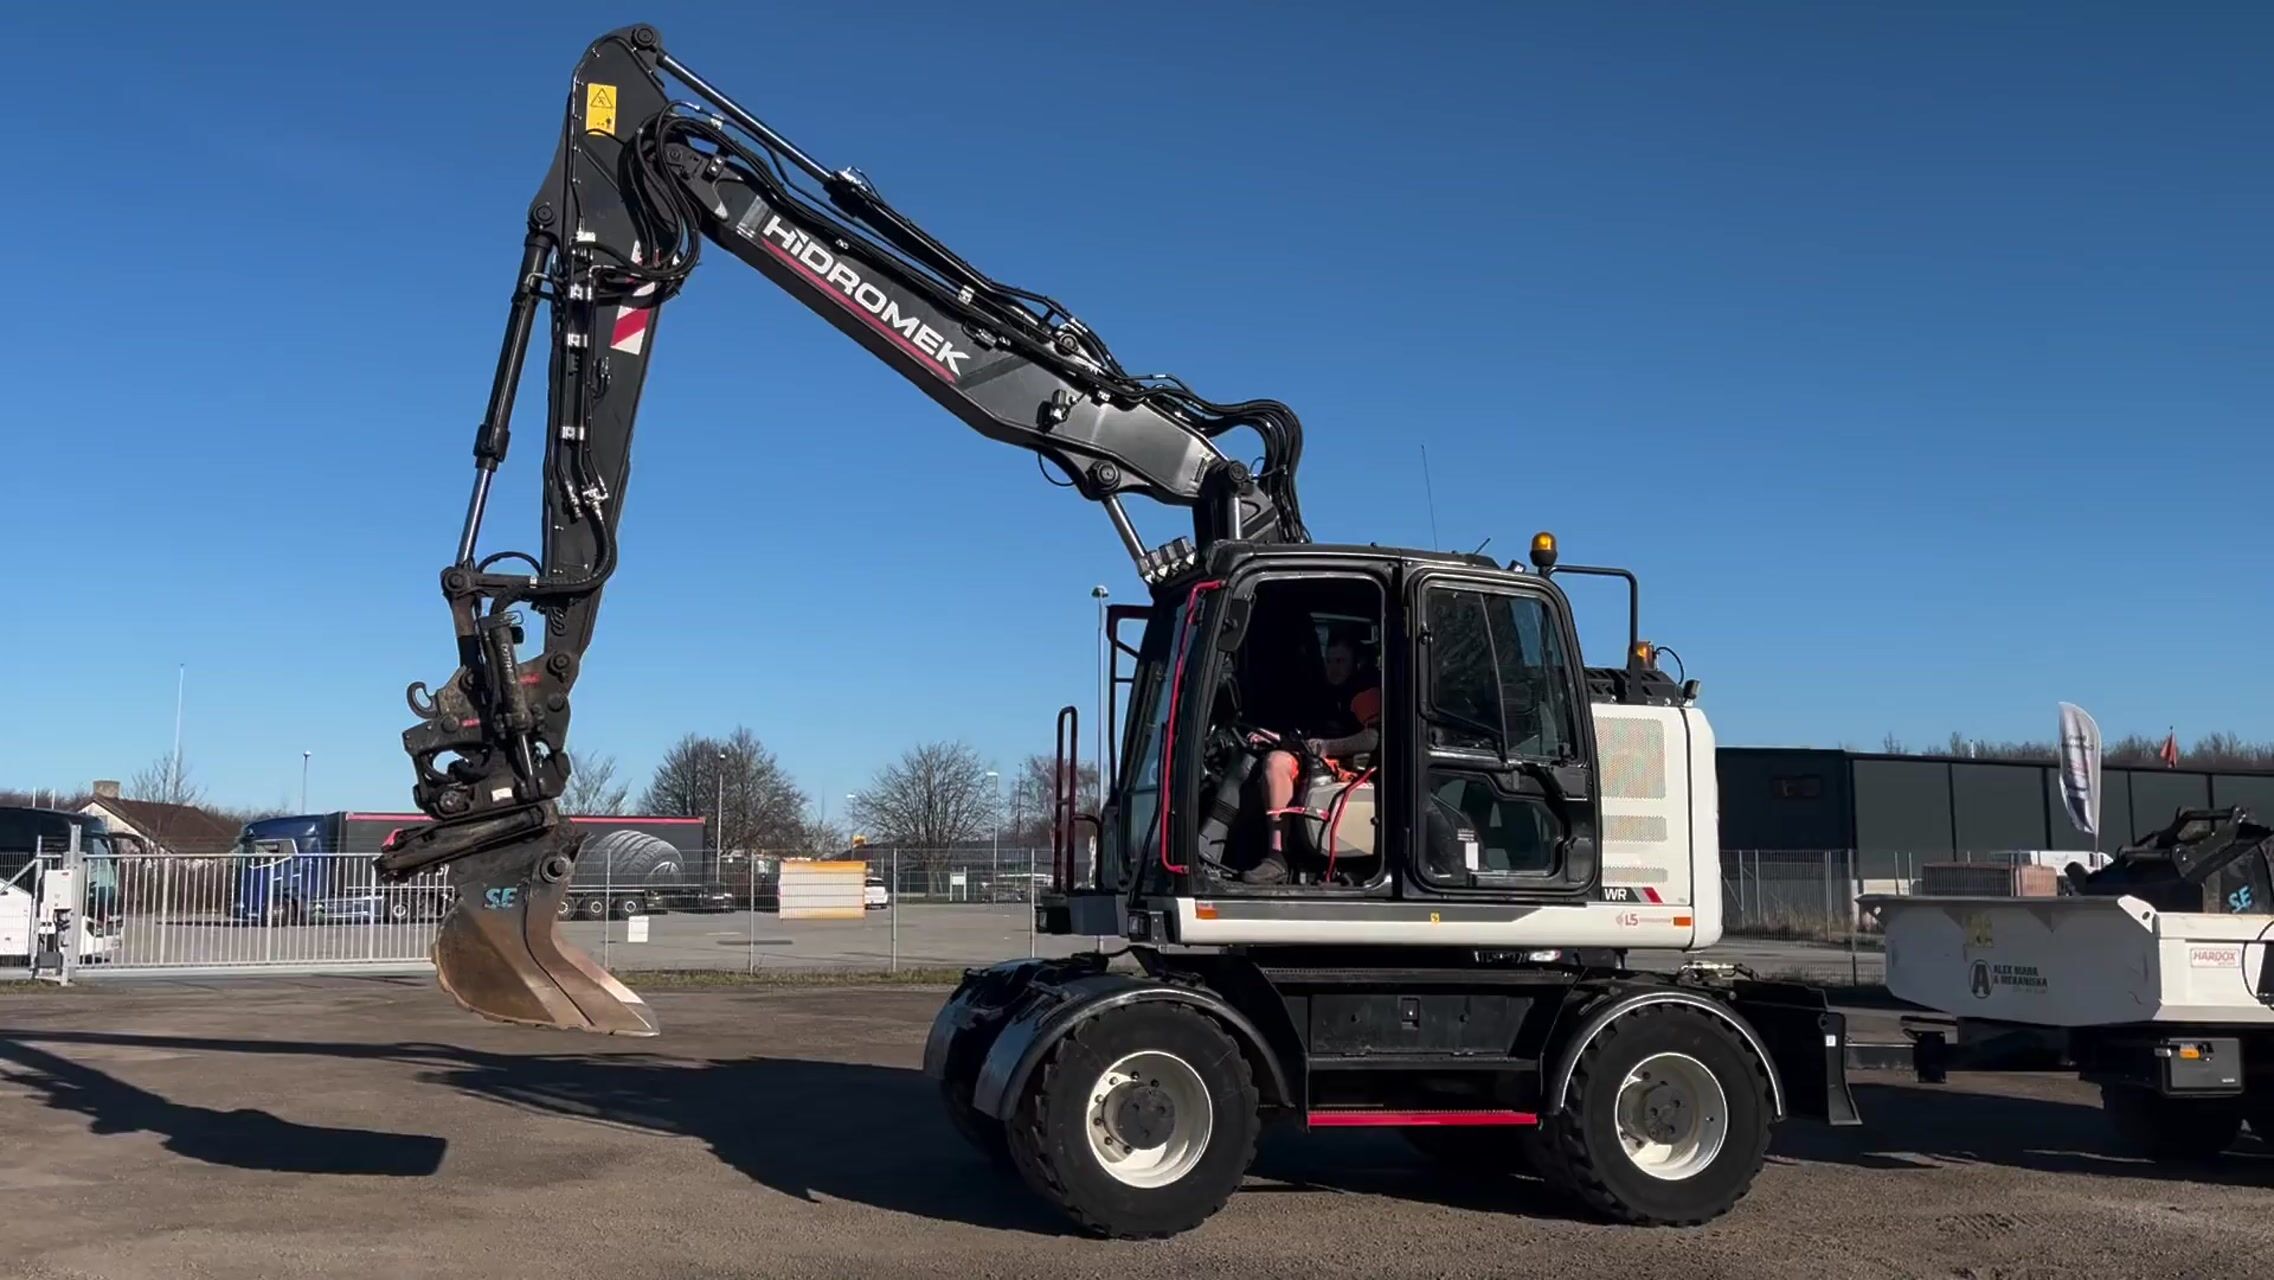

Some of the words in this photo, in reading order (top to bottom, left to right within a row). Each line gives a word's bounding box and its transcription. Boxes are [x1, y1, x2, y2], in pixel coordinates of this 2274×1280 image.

[484, 887, 518, 909] SE
[1604, 888, 1627, 901] WR
[2228, 885, 2252, 912] SE
[2193, 951, 2236, 961] HARDOX
[1994, 964, 2012, 974] ALEX
